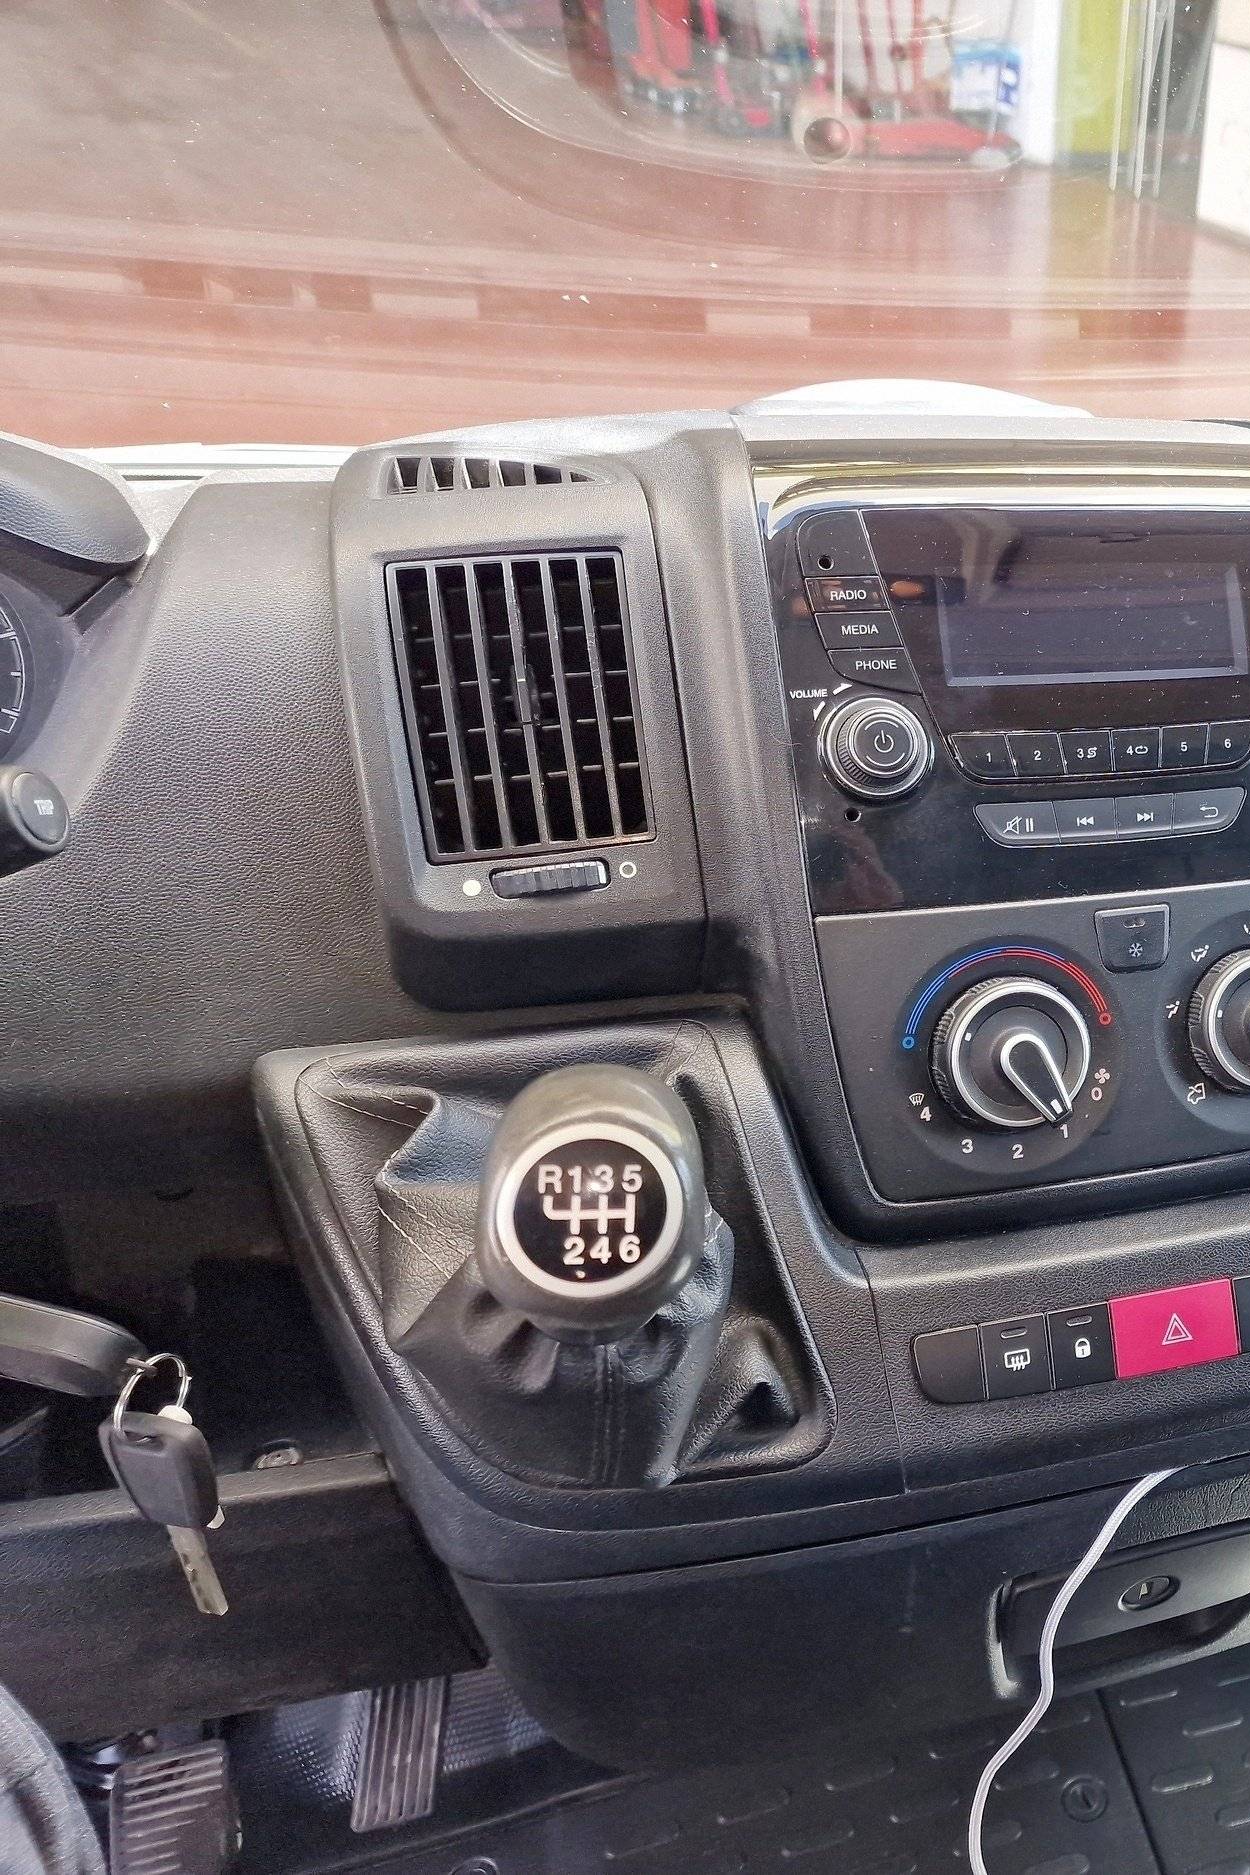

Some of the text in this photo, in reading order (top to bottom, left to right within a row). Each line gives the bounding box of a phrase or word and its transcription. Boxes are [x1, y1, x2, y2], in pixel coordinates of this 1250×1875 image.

[830, 590, 867, 601] RADIO
[841, 624, 879, 635] MEDIA
[855, 659, 898, 671] PHONE
[789, 689, 828, 699] VOLUME
[985, 738, 1232, 763] 1 2 3 4 5 6
[919, 1106, 932, 1122] 4
[1060, 1123, 1069, 1138] 1
[961, 1139, 974, 1154] 3
[1011, 1144, 1024, 1159] 2
[538, 1164, 563, 1194] R
[567, 1165, 582, 1193] 1
[621, 1164, 643, 1193] 5
[563, 1234, 641, 1265] 2 4 6
